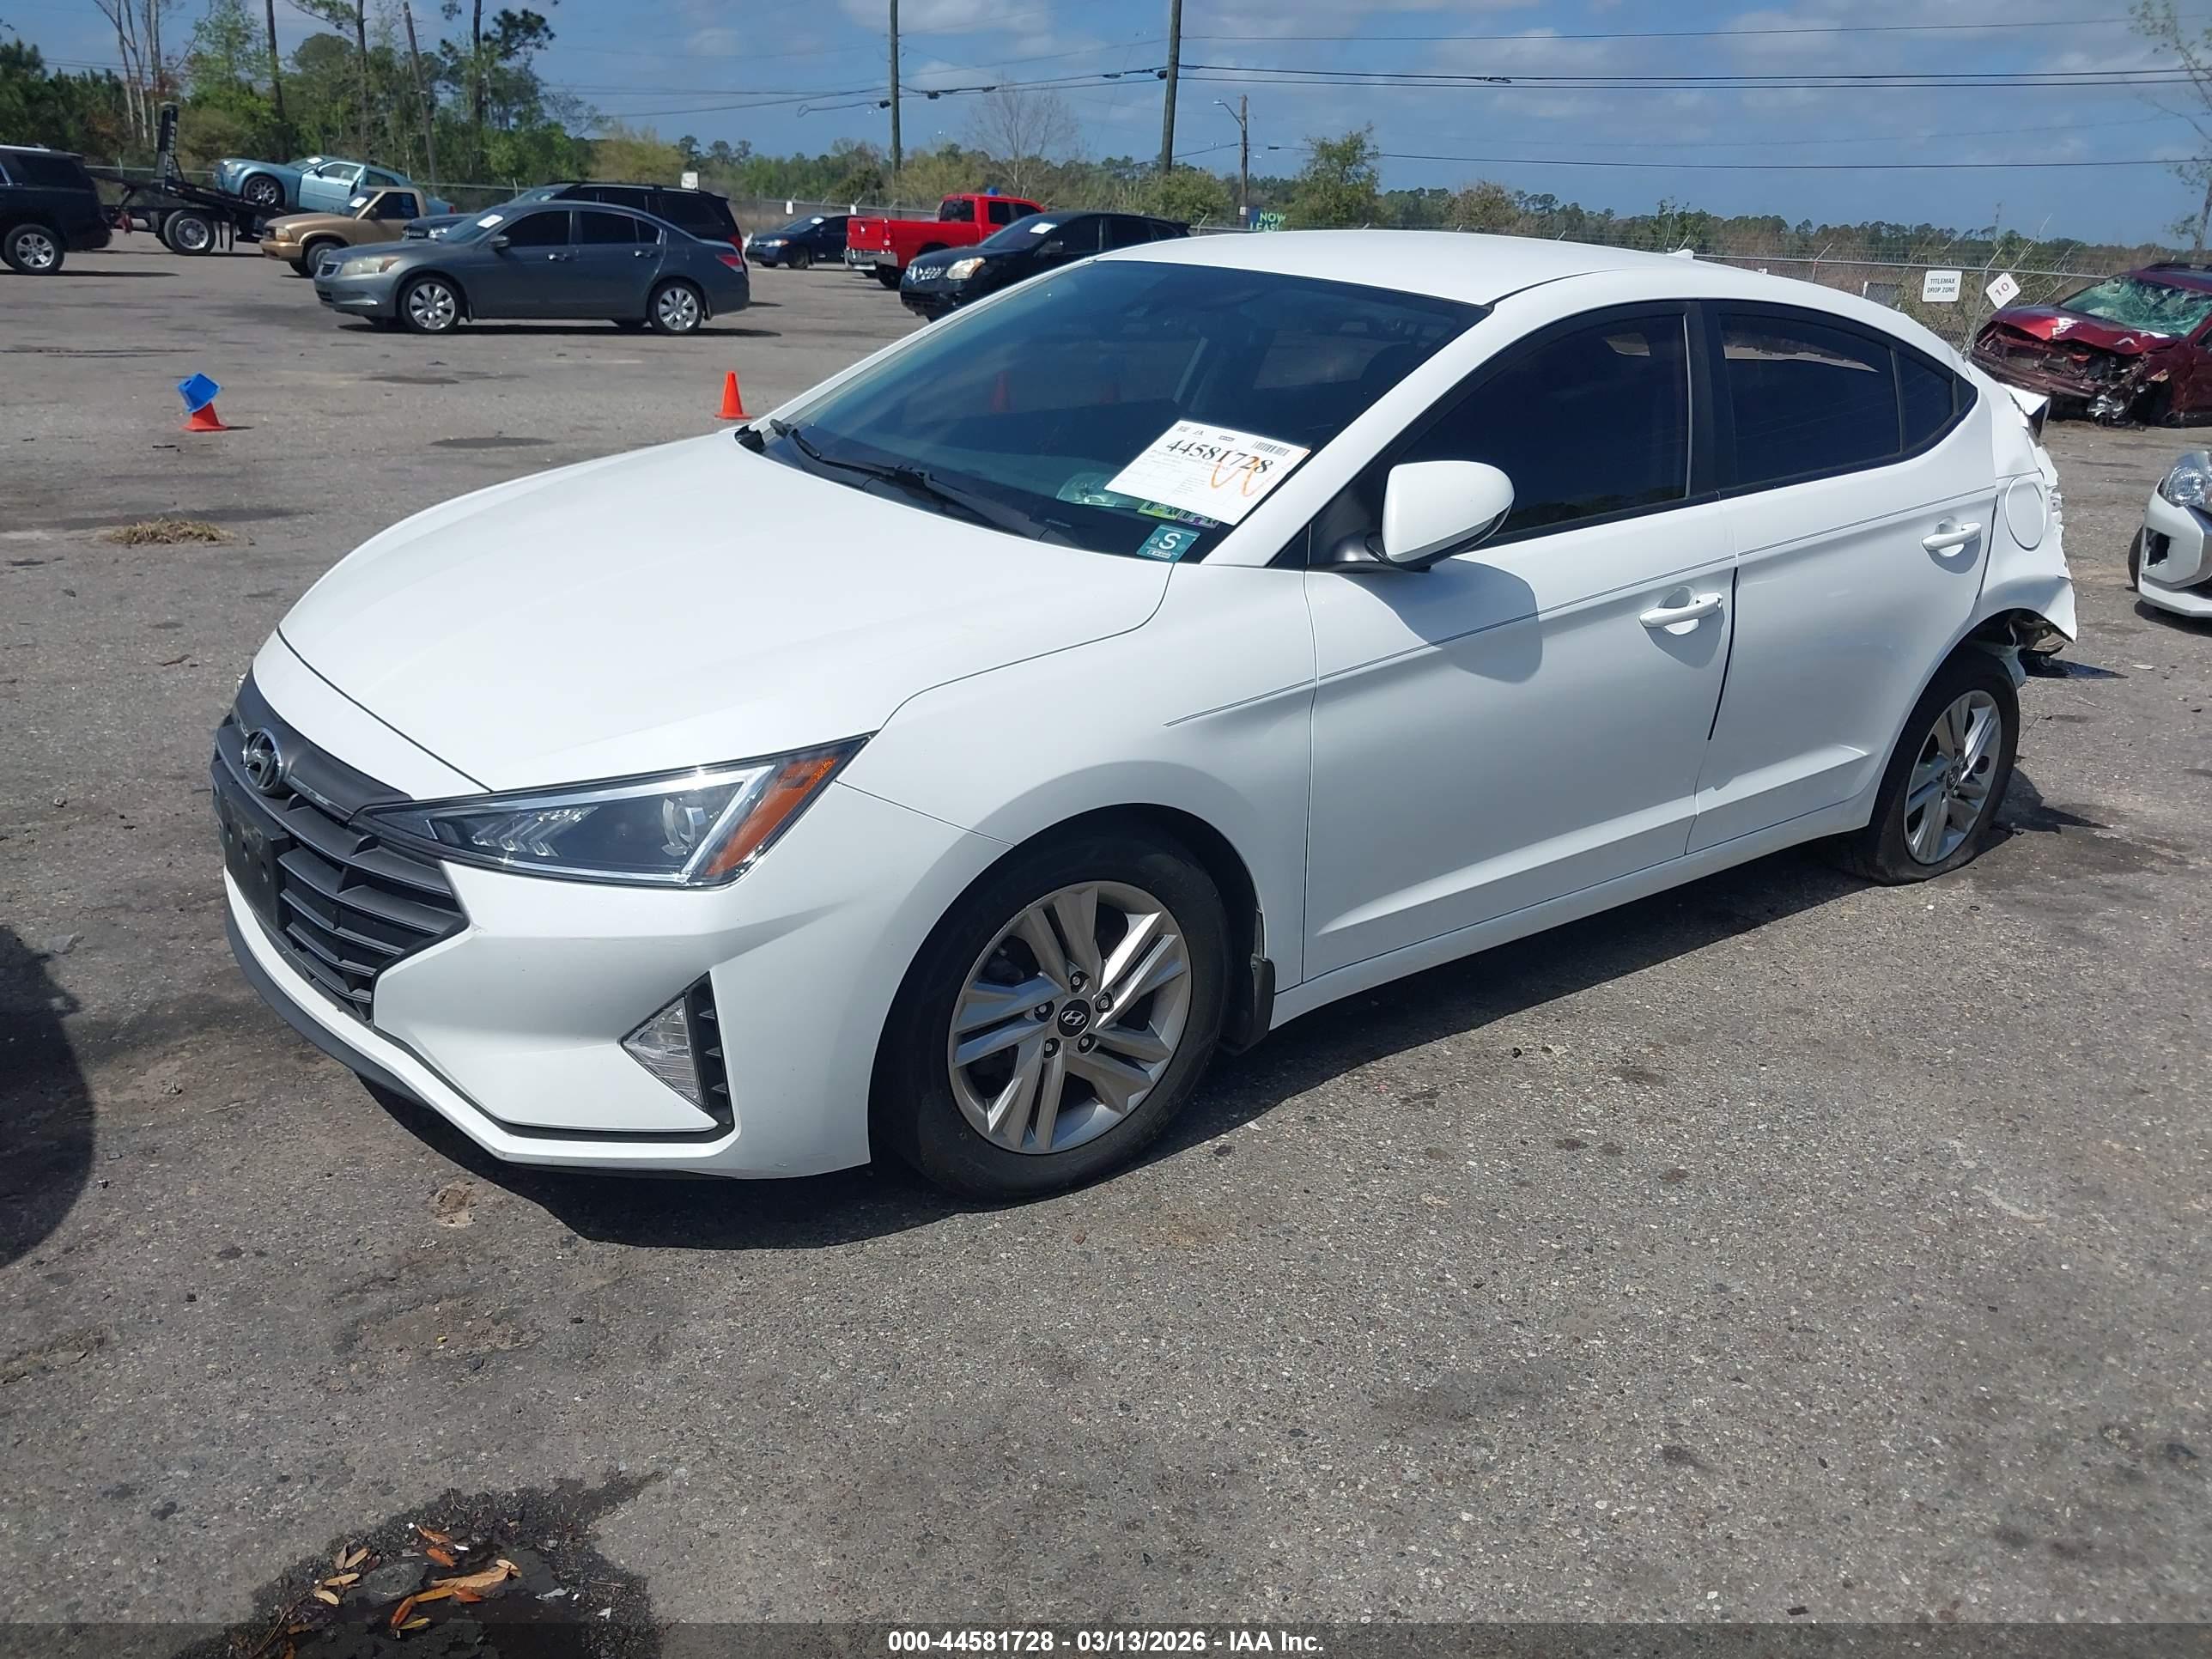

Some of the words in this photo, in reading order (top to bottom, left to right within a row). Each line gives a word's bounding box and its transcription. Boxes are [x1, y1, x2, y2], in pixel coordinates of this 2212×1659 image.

[1260, 213, 1286, 222] NOW
[1995, 283, 2010, 296] 10
[1166, 440, 1273, 473] 44581728
[1158, 532, 1182, 550] S
